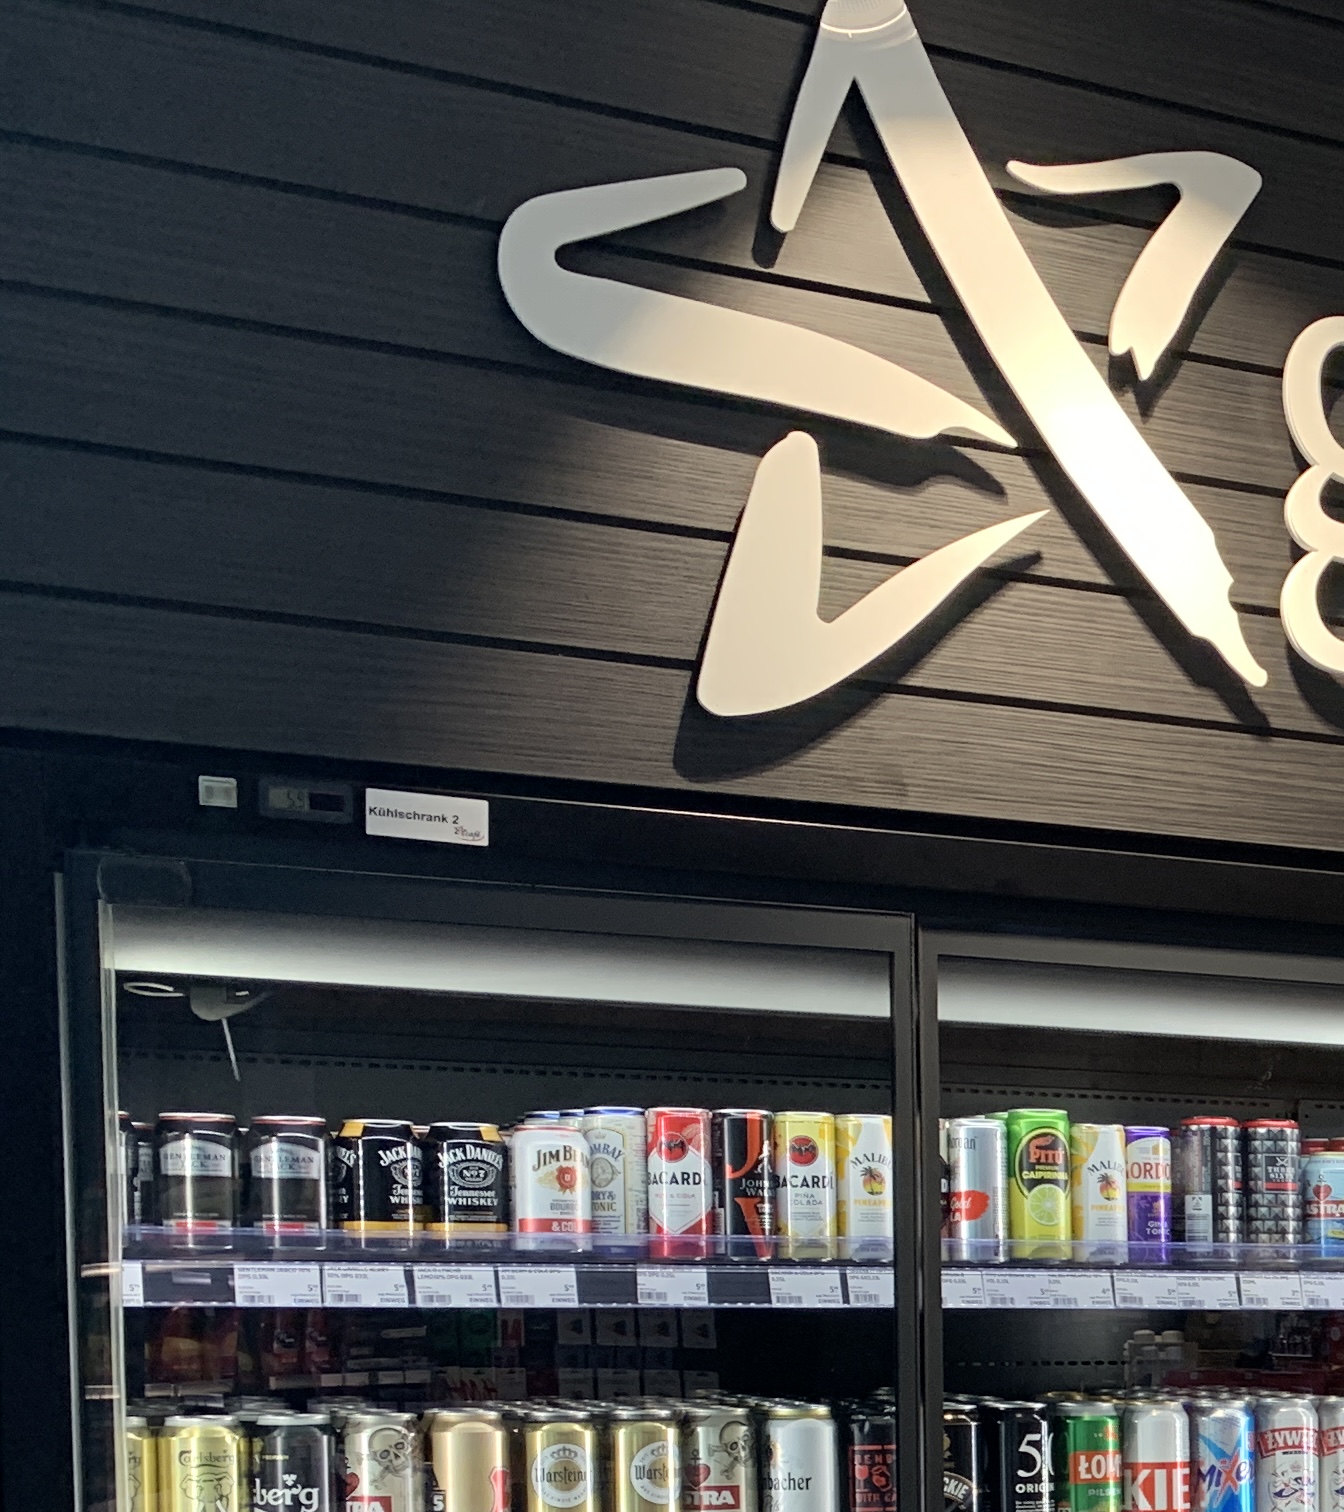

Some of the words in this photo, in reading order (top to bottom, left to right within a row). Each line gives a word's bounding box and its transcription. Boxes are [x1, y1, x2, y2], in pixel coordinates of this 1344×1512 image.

[369, 806, 448, 824] Kühlschrank
[452, 815, 459, 824] 2
[533, 1148, 559, 1170] JIM
[448, 1197, 498, 1206] WHISKEY
